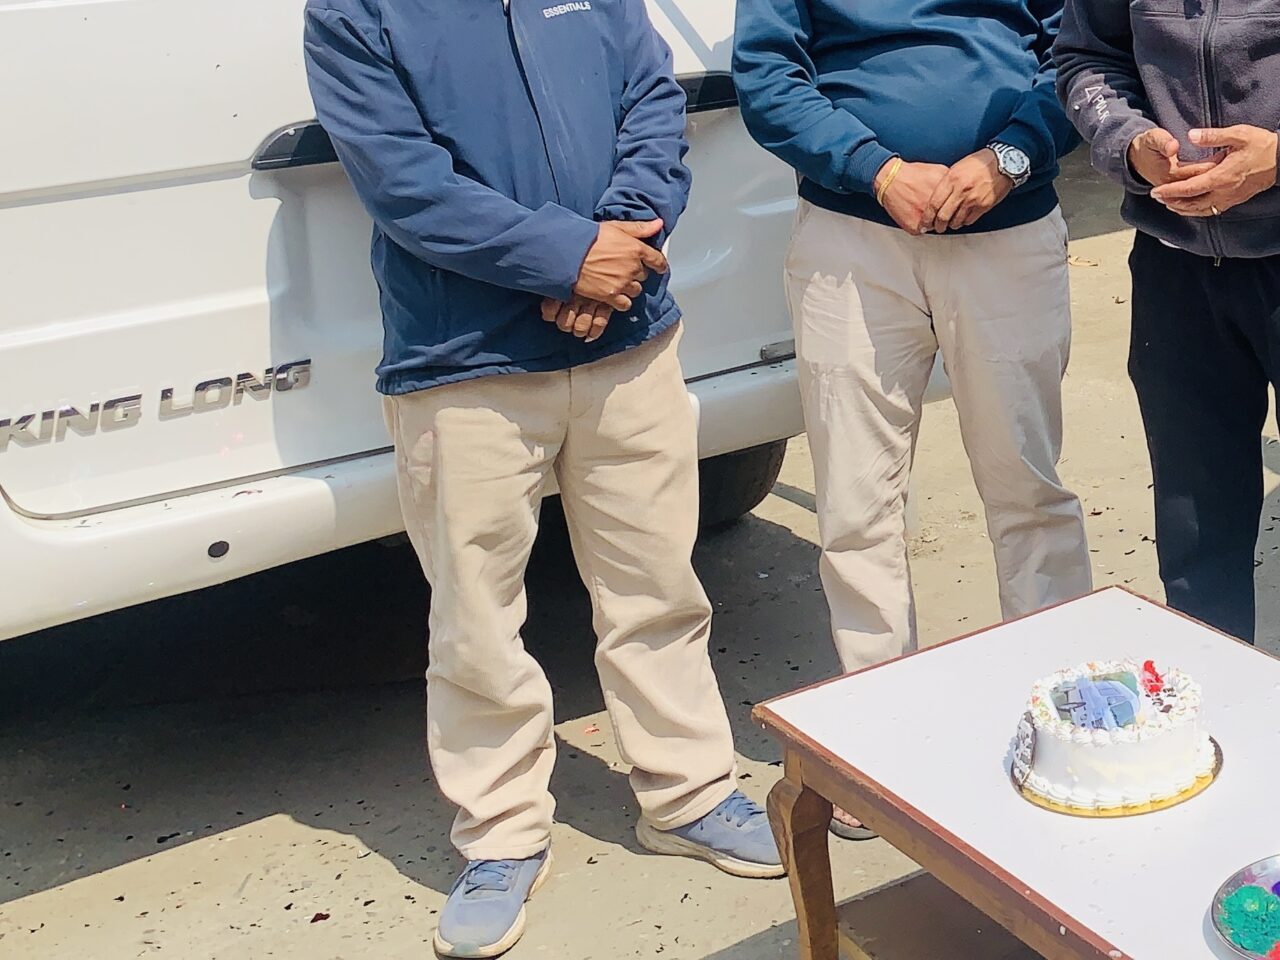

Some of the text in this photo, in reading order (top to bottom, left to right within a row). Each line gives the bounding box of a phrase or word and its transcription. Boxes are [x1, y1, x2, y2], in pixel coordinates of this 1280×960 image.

[542, 1, 591, 18] ESSENTIALS
[0, 358, 311, 452] KING LONG
